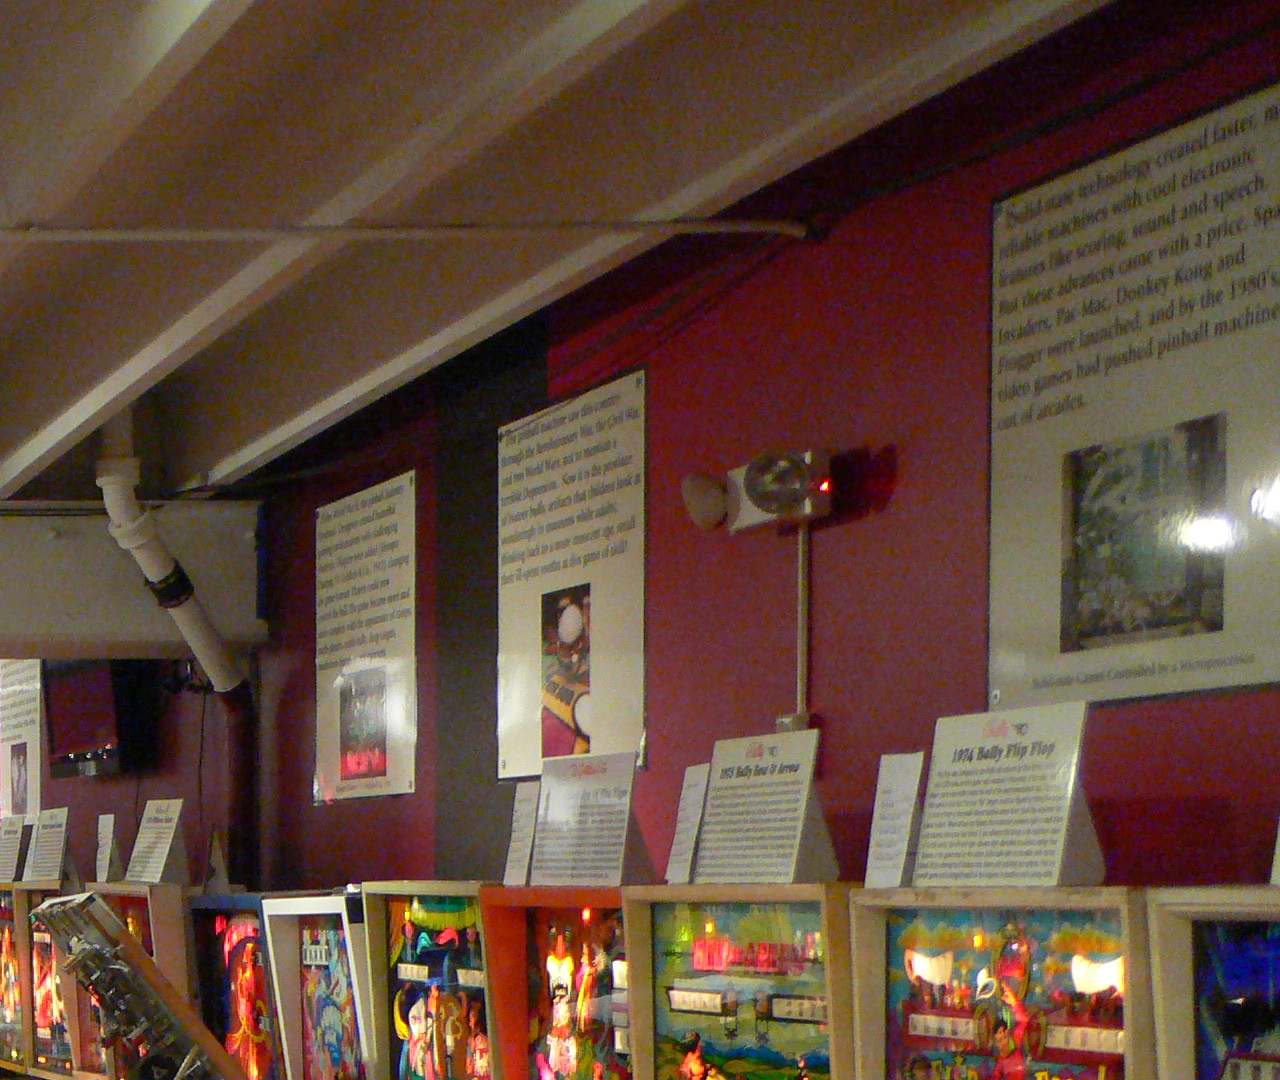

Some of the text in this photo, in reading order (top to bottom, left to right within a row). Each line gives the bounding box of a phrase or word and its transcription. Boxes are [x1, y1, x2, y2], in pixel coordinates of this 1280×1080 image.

[1156, 129, 1207, 166] created
[1112, 189, 1141, 214] with
[1145, 175, 1175, 201] cool
[1181, 143, 1255, 188] electronic
[1132, 207, 1175, 237] sound
[1181, 194, 1207, 219] and
[1023, 284, 1051, 308] these
[1056, 261, 1113, 297] advances
[1118, 249, 1153, 274] came
[1158, 233, 1188, 260] with
[1116, 270, 1168, 309] Donkey
[1174, 257, 1211, 290] Kong
[1218, 243, 1244, 270] and
[1149, 300, 1173, 325] and
[1200, 284, 1222, 307] the
[1034, 367, 1071, 394] games
[1076, 355, 1099, 377] had
[1104, 338, 1152, 373] pushed
[1158, 319, 1207, 357] pinball
[977, 745, 1003, 762] Bally
[1005, 742, 1028, 760] Flip
[1030, 741, 1056, 759] Flop
